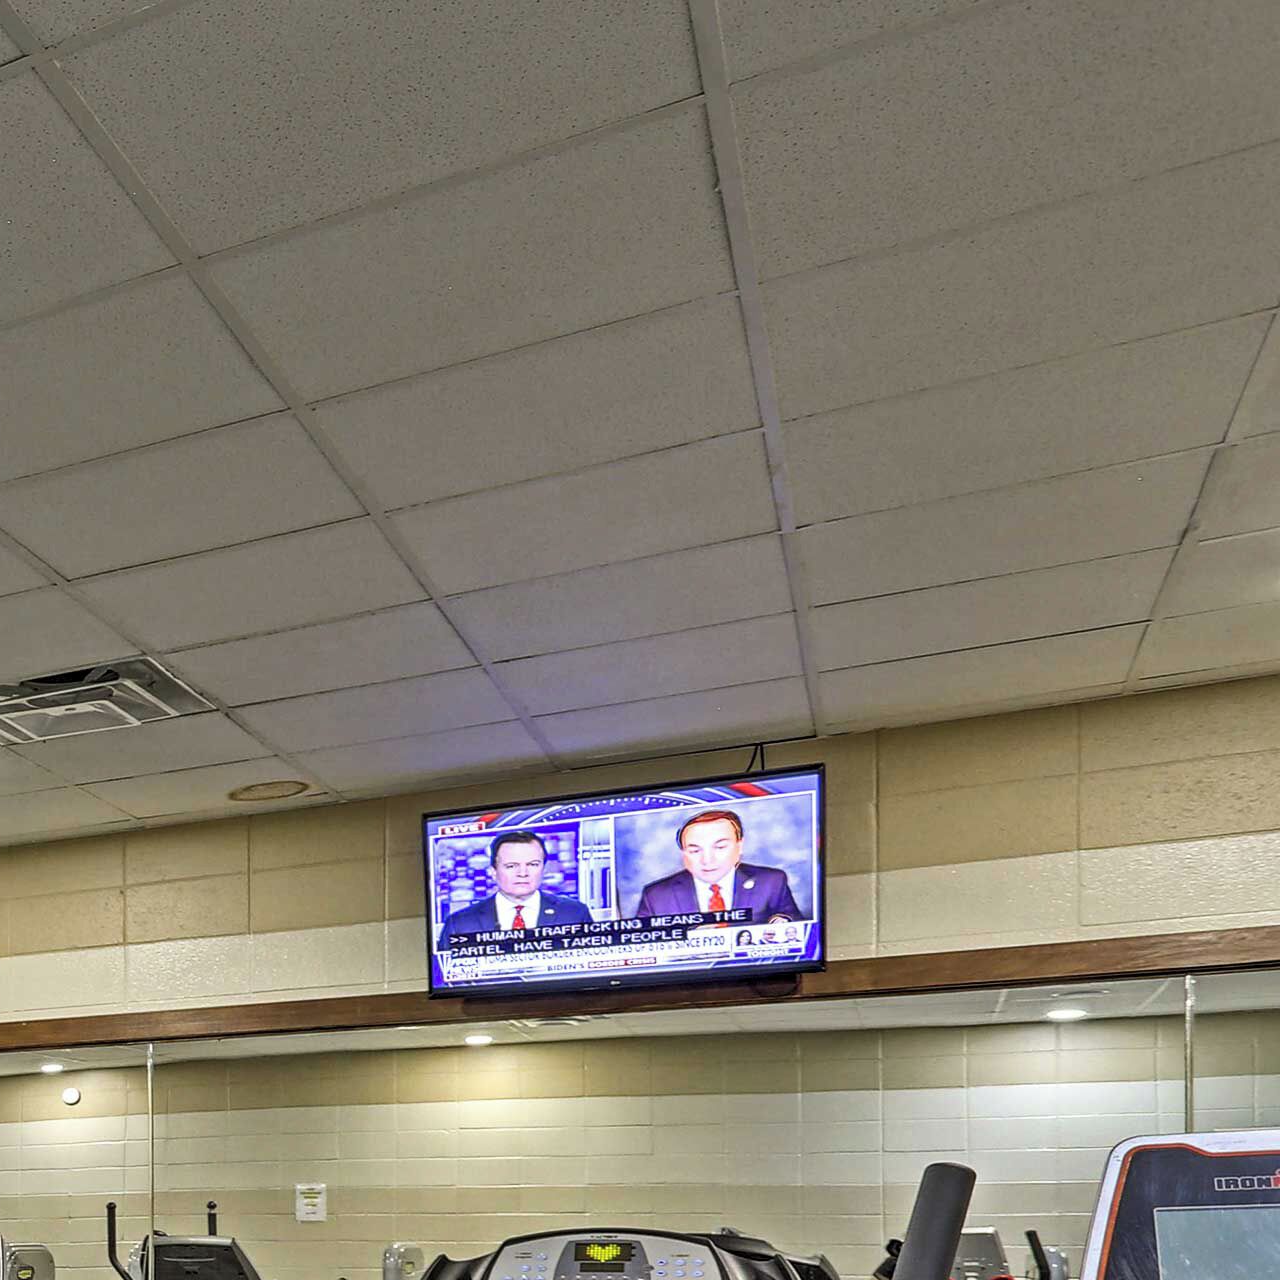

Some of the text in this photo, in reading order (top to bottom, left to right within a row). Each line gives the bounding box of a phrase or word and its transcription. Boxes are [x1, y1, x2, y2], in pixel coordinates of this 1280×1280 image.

[476, 930, 525, 942] HUMAN
[534, 919, 642, 937] TRAFFICKING
[650, 914, 704, 928] MEANS
[713, 910, 747, 921] THE
[451, 929, 684, 957] CARTEL HAVE TAKEN PEOPLE
